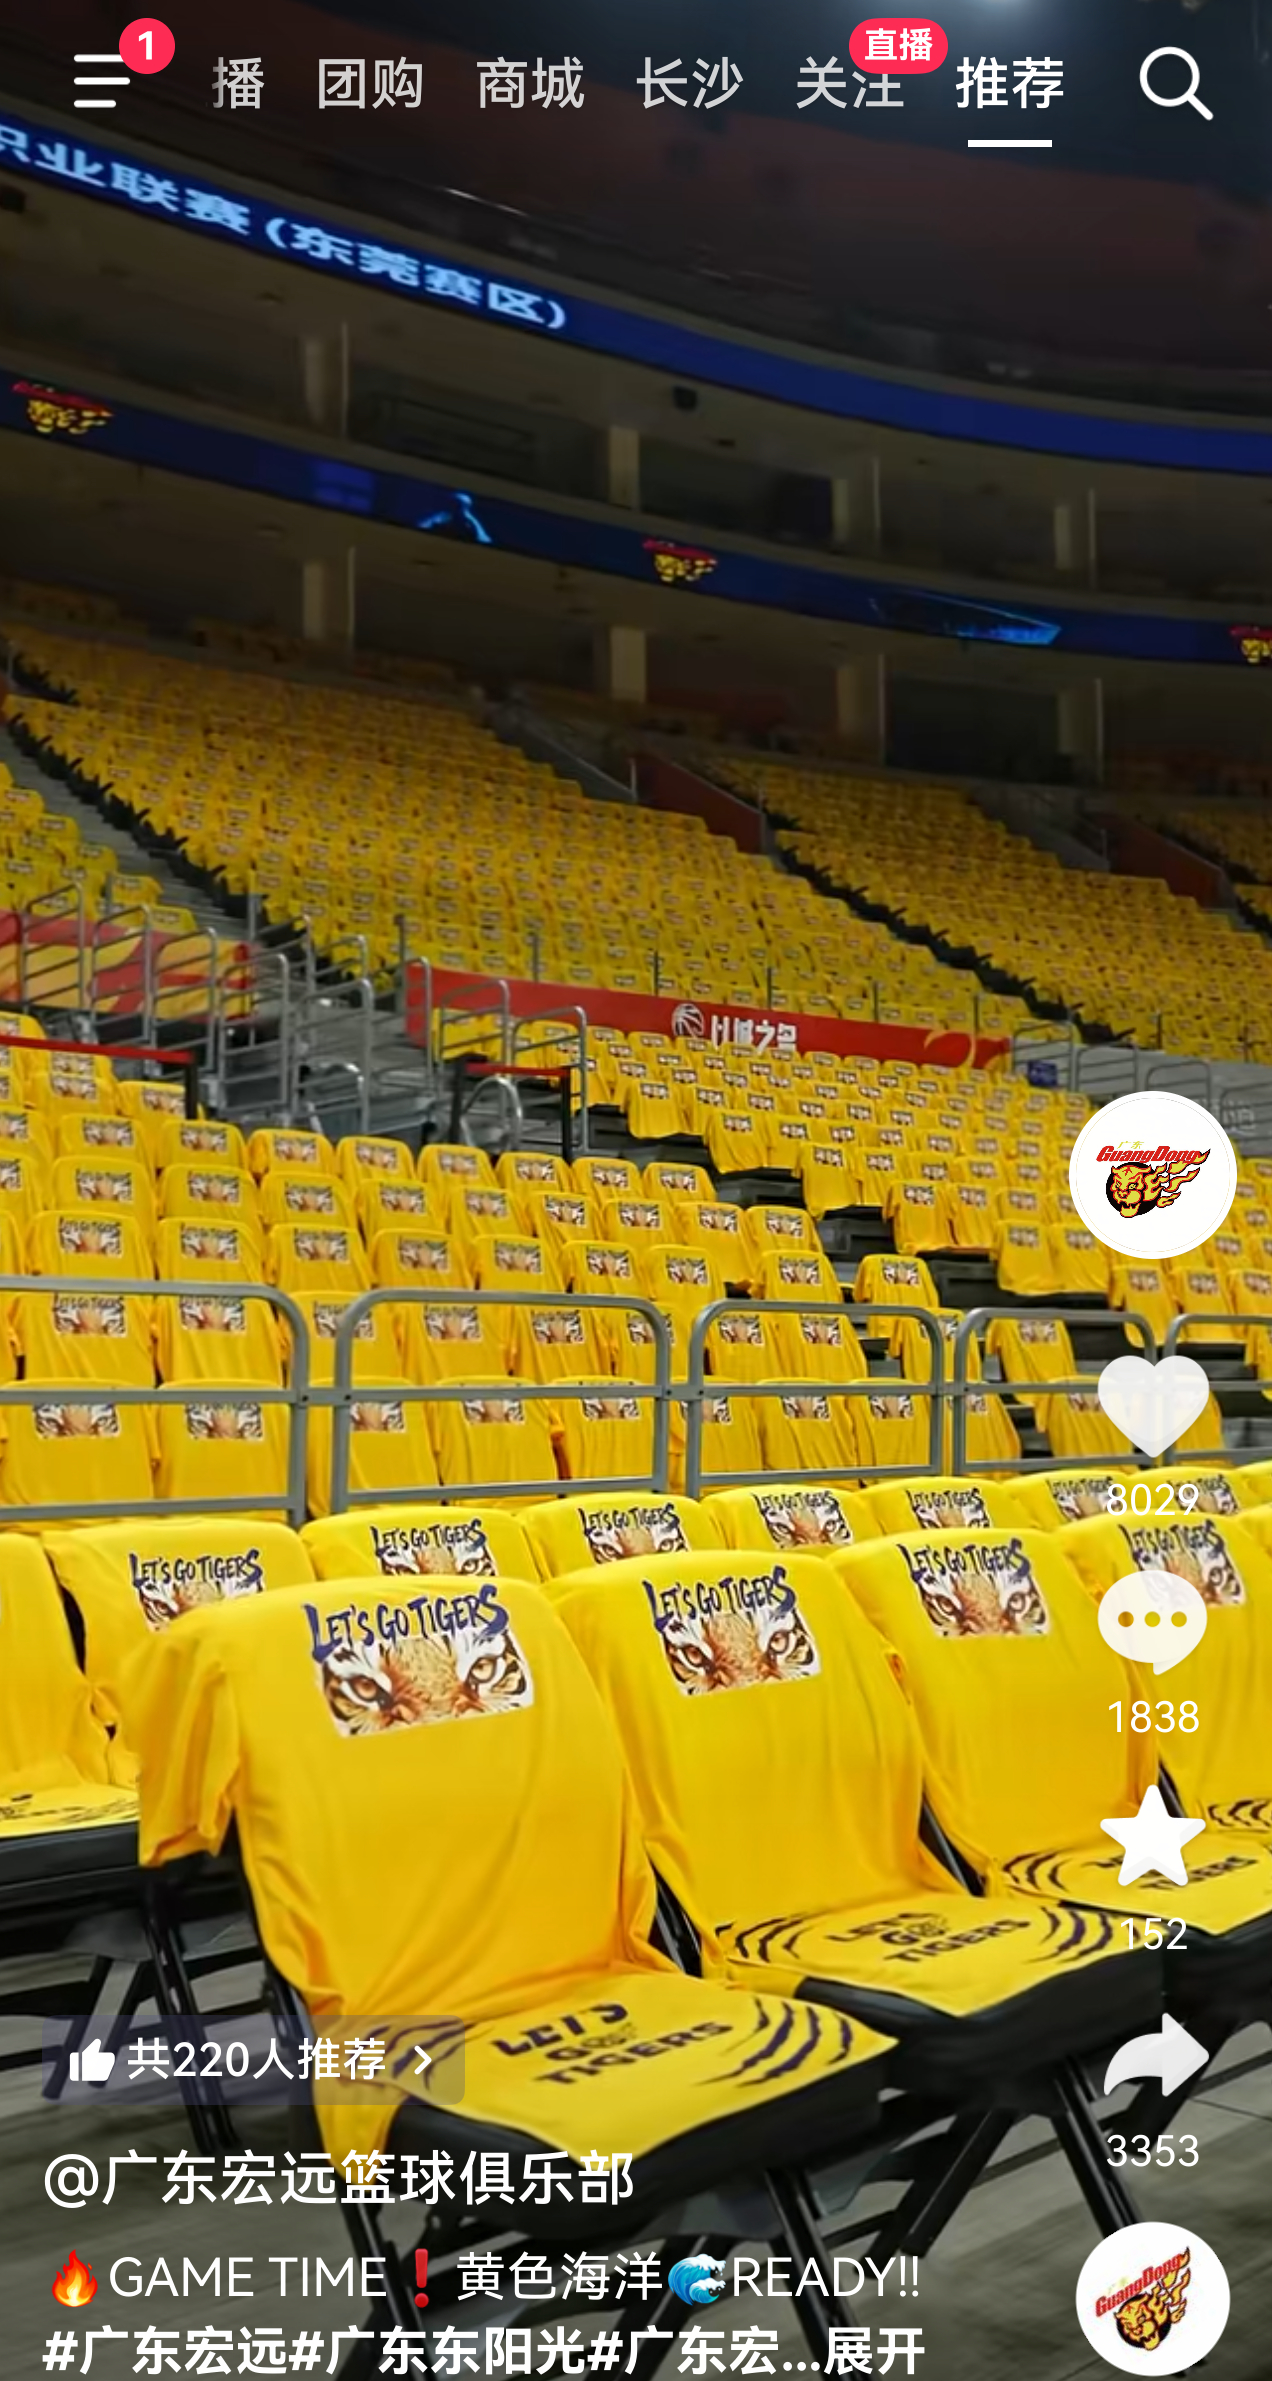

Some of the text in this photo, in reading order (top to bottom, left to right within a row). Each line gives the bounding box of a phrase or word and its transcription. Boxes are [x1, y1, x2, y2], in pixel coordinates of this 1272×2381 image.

[369, 1517, 486, 1558] LET'S GO TIGERS
[577, 1502, 680, 1537] LET'S GO TIGERS
[1117, 1518, 1225, 1560] LET'S GO TIGERS
[129, 1548, 263, 1588] LET'S GO TIGERS
[896, 1537, 1031, 1584] LET'S GO TIGERS
[641, 1564, 796, 1634] LET'S GO TIGERS
[303, 1583, 509, 1663] LET'S GO TIGERS
[532, 2021, 734, 2084] TIGERS
